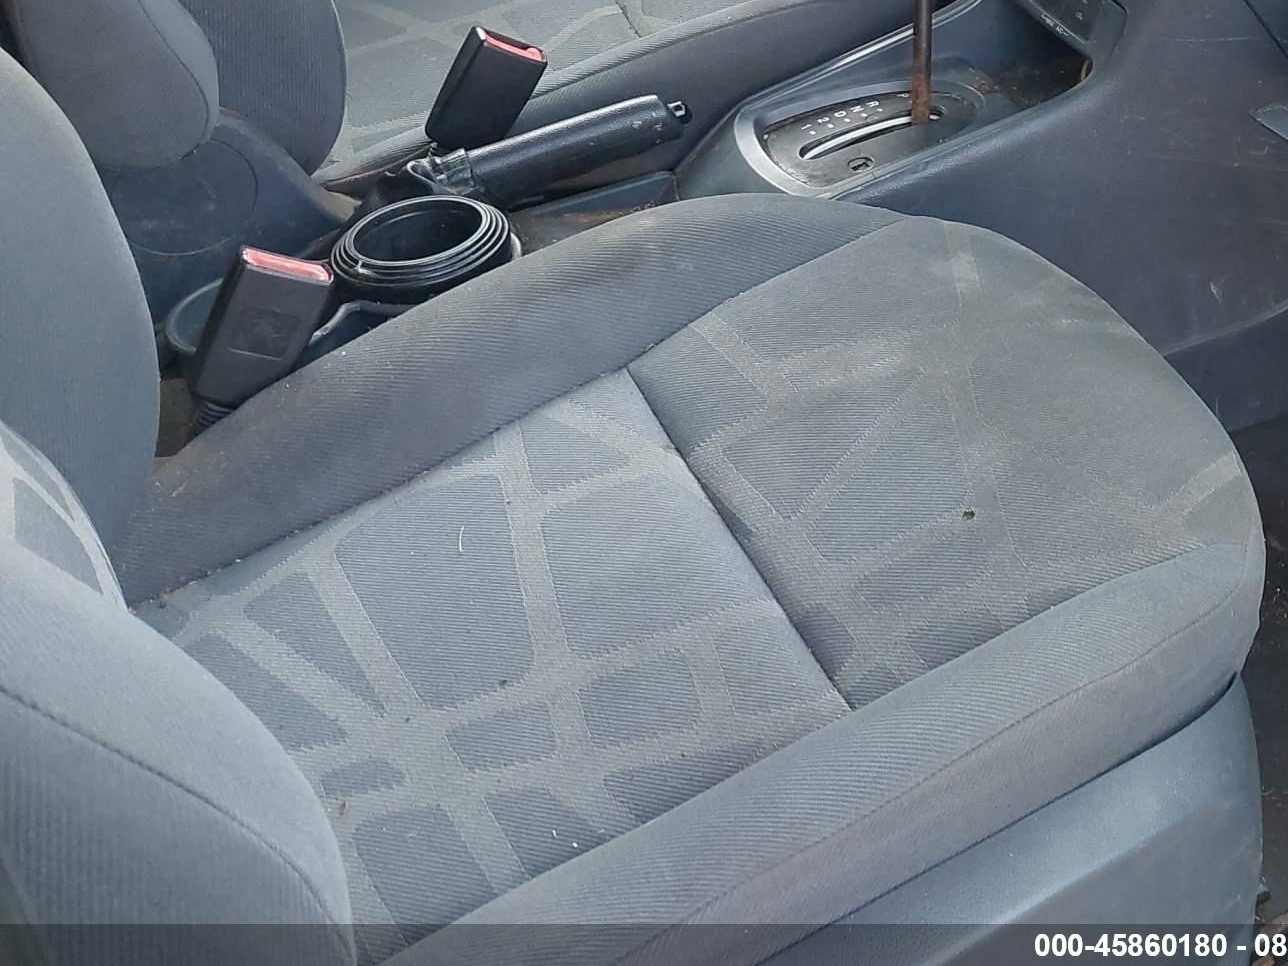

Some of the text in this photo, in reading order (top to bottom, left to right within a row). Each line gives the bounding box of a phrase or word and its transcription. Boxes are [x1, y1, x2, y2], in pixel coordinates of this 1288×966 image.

[866, 100, 880, 108] R
[850, 105, 864, 113] N
[834, 110, 847, 118] D
[817, 116, 830, 124] 2
